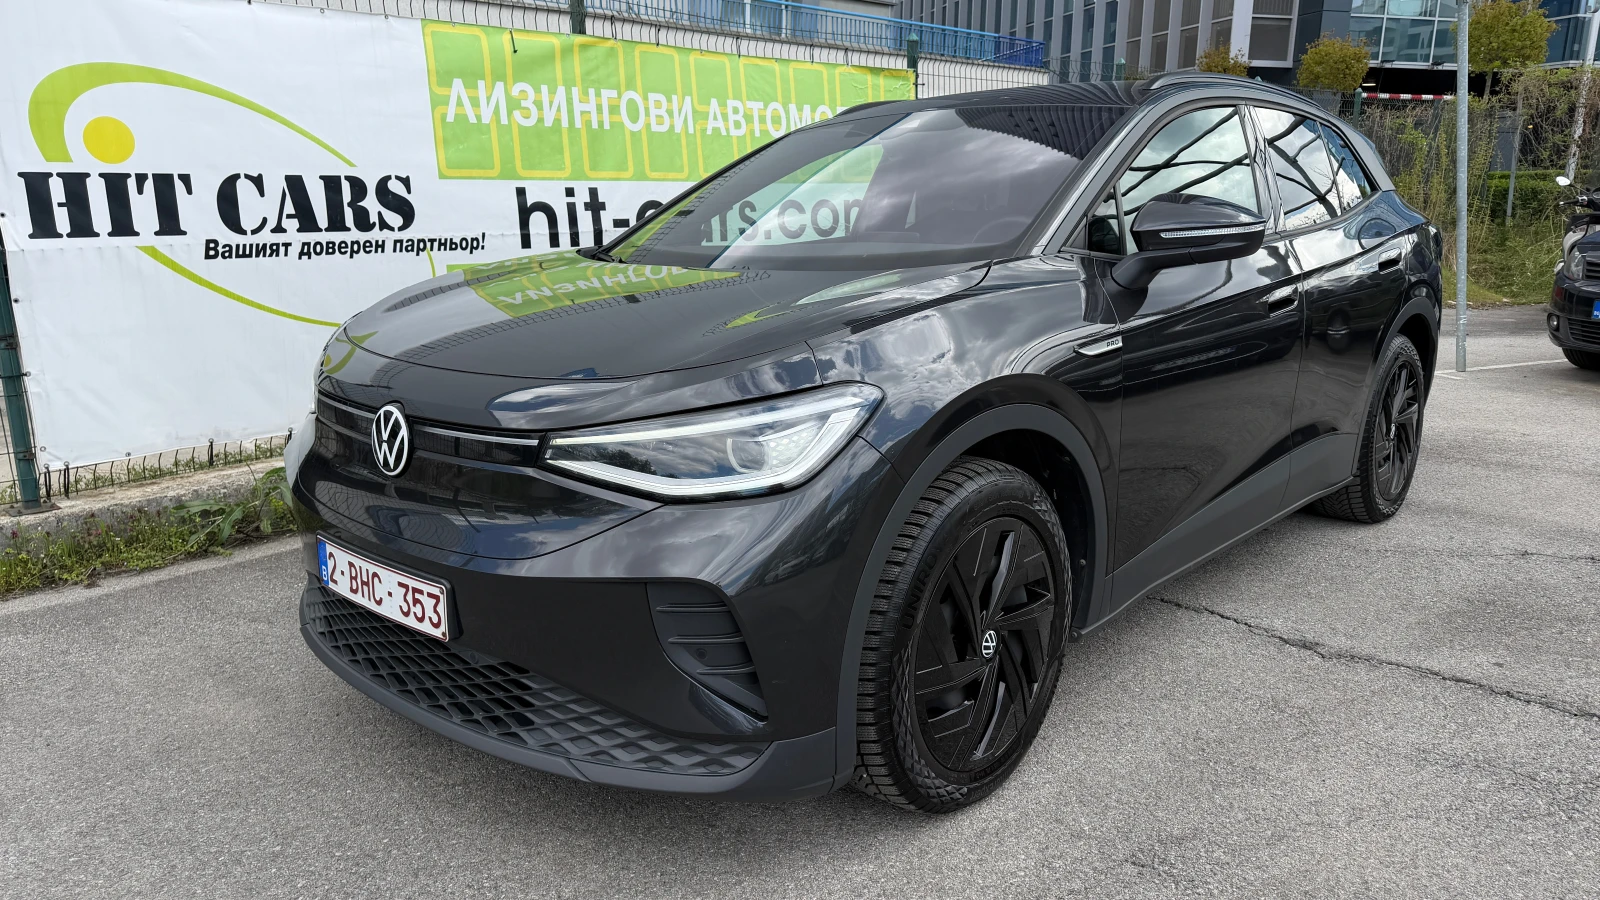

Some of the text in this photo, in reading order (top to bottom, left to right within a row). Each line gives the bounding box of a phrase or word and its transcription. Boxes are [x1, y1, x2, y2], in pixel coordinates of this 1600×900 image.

[446, 77, 850, 138] ЛИЗИНГОВИ АВТОМ
[18, 171, 416, 239] HIT CARS
[204, 232, 486, 260] Вашият доверен партньор!
[1107, 339, 1119, 347] PRO
[322, 566, 328, 581] B
[328, 552, 442, 629] 2-BHC-353
